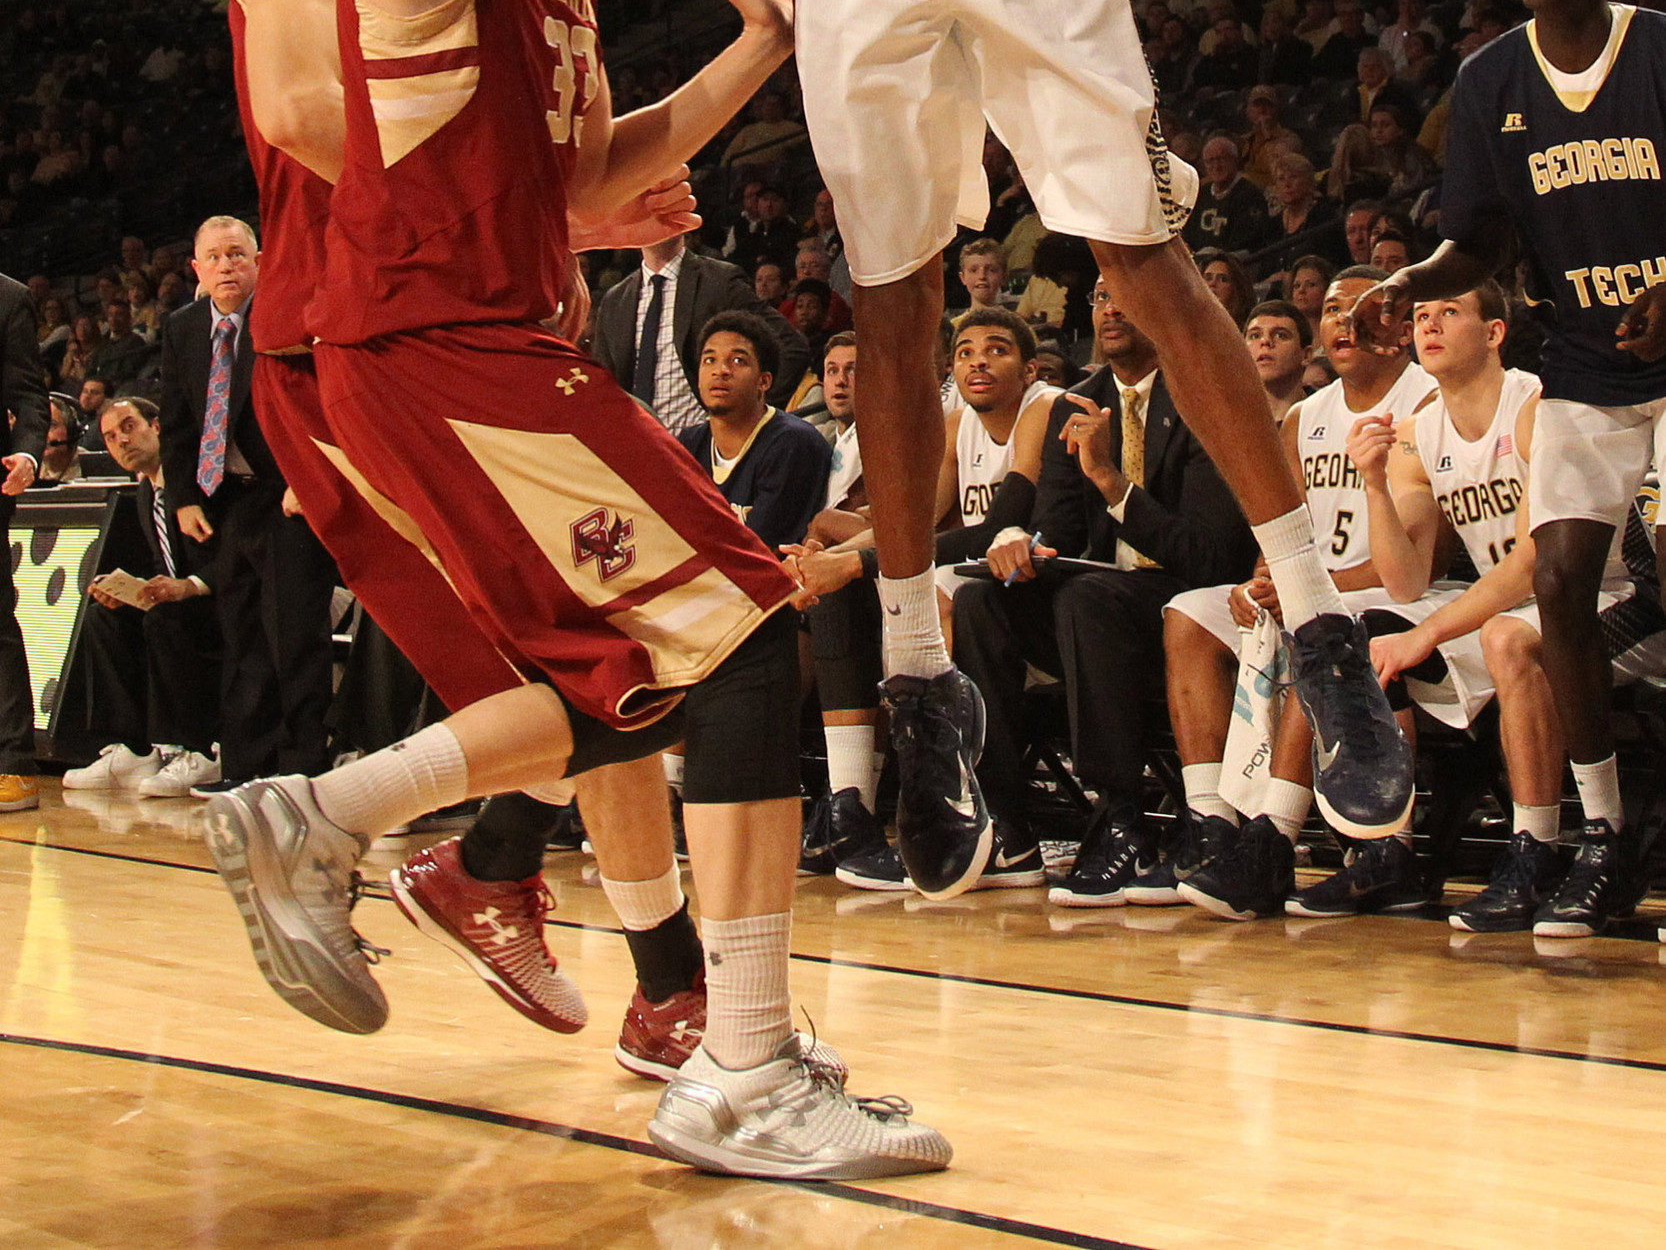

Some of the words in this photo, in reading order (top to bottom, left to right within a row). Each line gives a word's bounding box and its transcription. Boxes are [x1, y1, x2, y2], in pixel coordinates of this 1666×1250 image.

[544, 16, 599, 148] 33
[1528, 137, 1661, 195] GEORGIA
[1565, 256, 1666, 308] TECH
[569, 507, 636, 583] BC
[1331, 510, 1353, 556] 5
